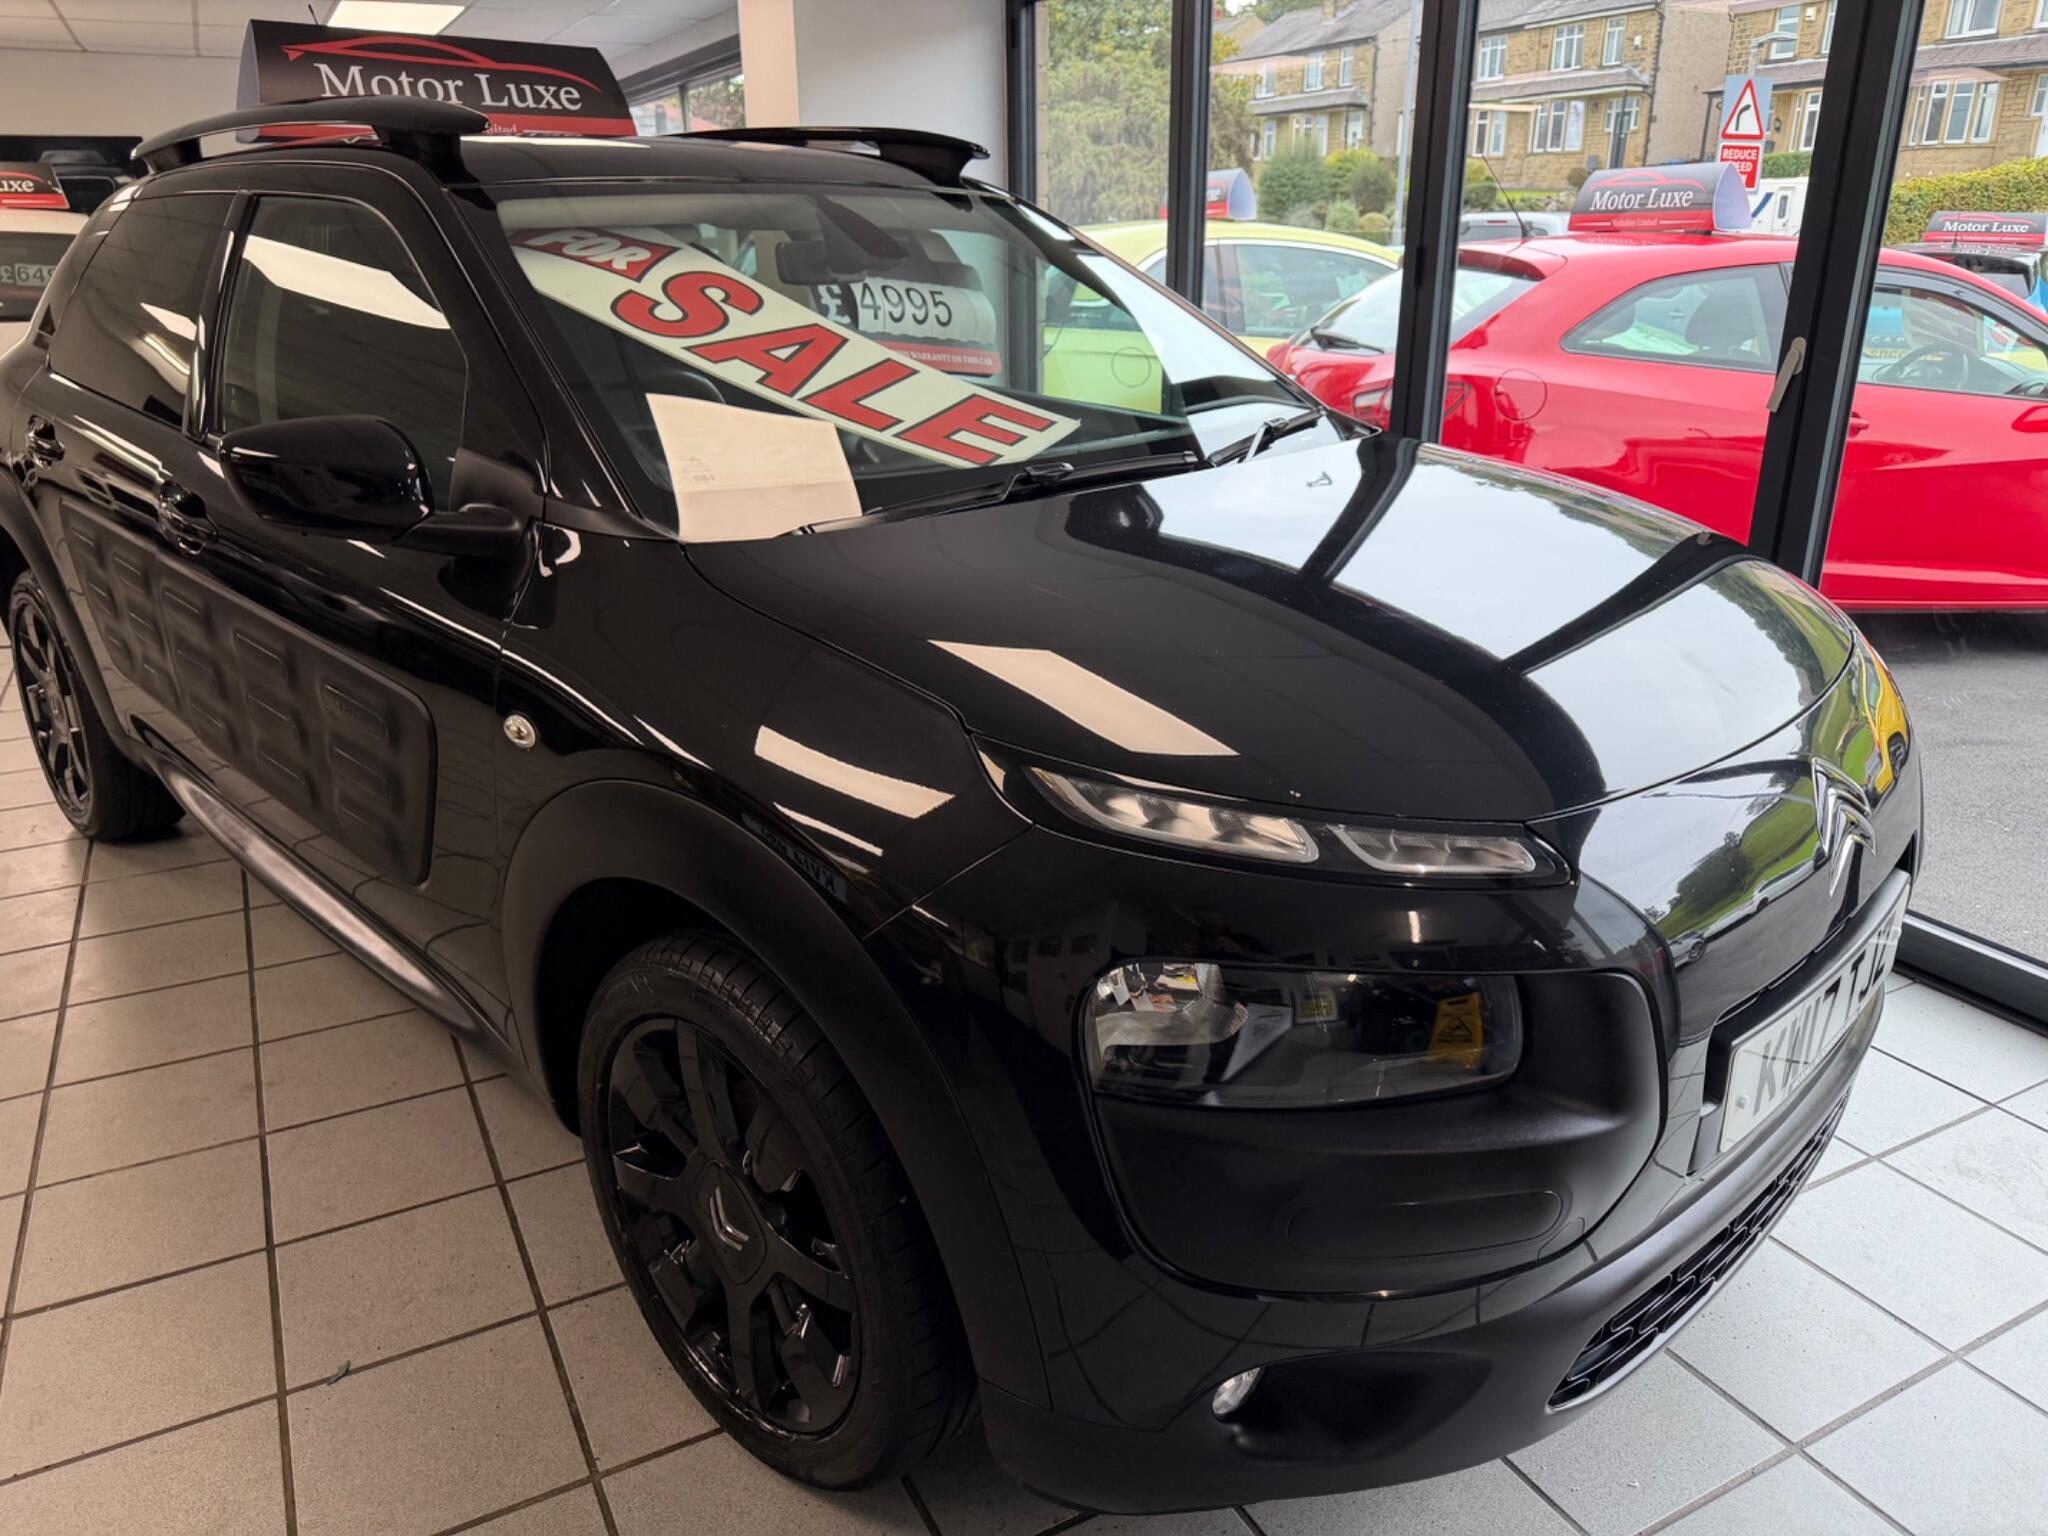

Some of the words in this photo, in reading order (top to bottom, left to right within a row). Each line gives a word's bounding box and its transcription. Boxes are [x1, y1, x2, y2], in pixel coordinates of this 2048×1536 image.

[314, 63, 463, 103] Motor
[475, 74, 582, 111] Luxe
[1723, 148, 1758, 160] REDUCE
[1589, 190, 1645, 210] Motor
[1646, 188, 1694, 208] Luxe
[1942, 221, 1989, 232] Motor
[1991, 221, 2030, 233] Luxe
[529, 227, 652, 272] FOR
[611, 271, 1055, 465] SALE
